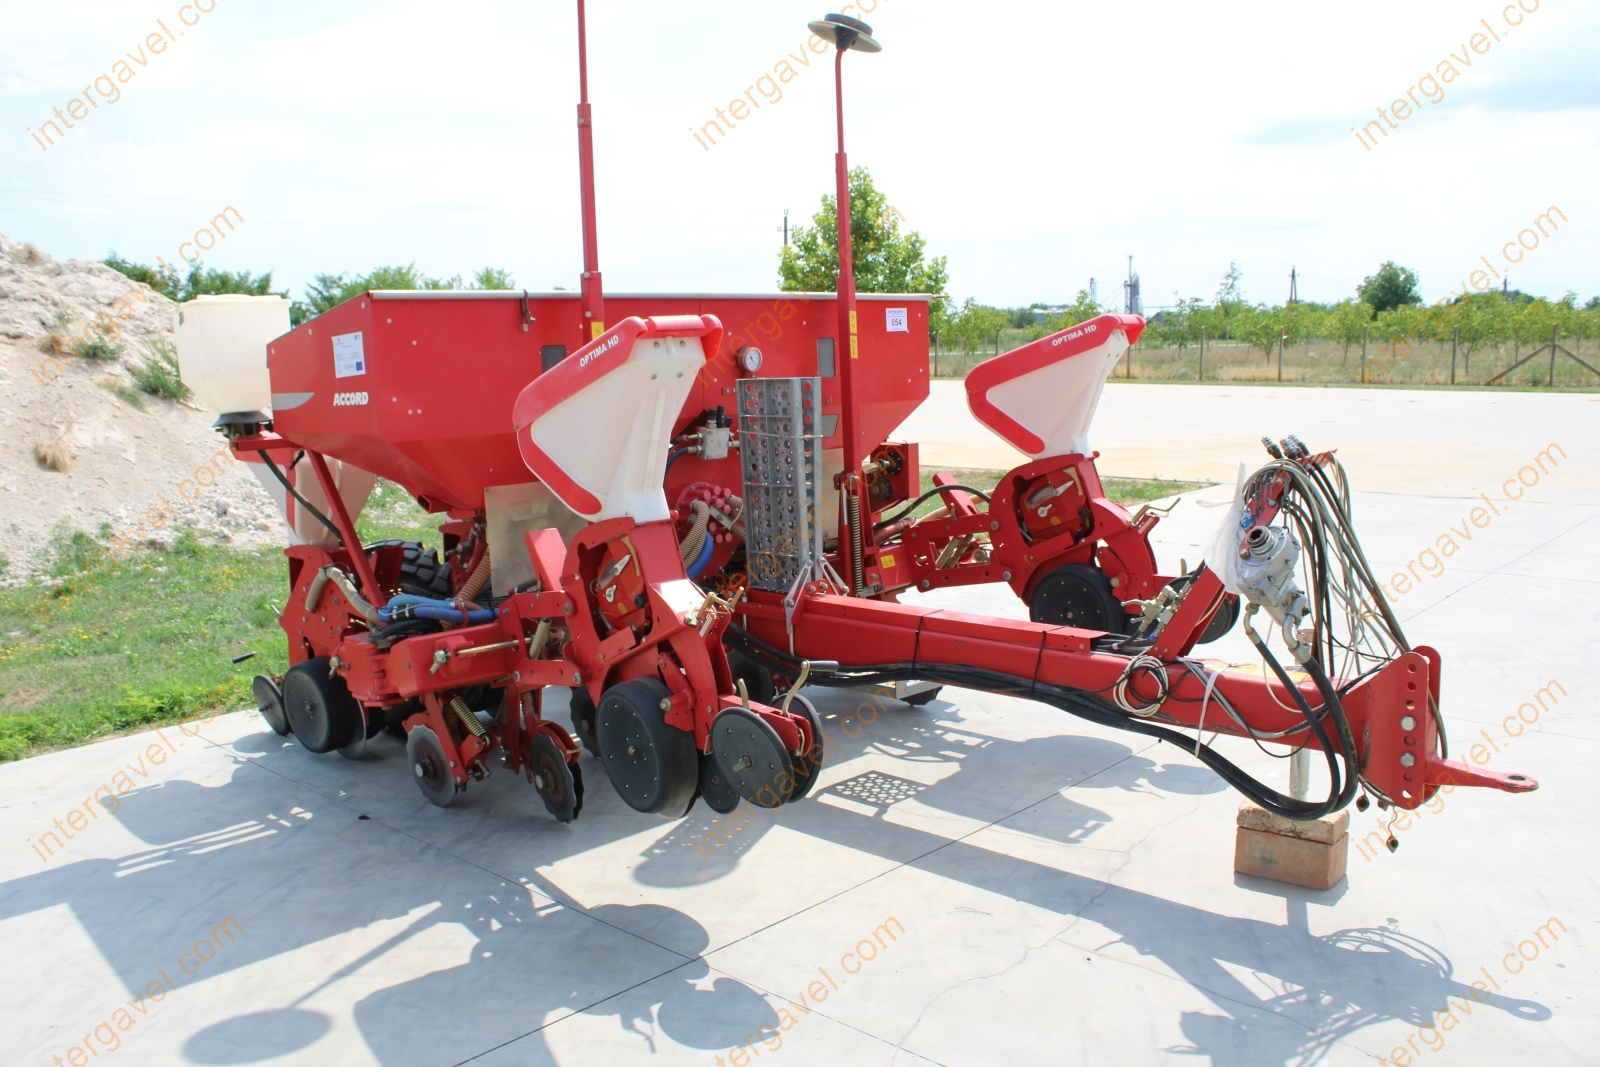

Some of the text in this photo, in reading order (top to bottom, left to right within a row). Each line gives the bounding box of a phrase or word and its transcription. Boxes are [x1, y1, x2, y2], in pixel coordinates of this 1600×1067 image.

[891, 318, 902, 326] 054
[1052, 324, 1097, 346] OPTIMA HD
[580, 335, 618, 366] OPTIMA HD
[333, 391, 369, 406] ACCORD
